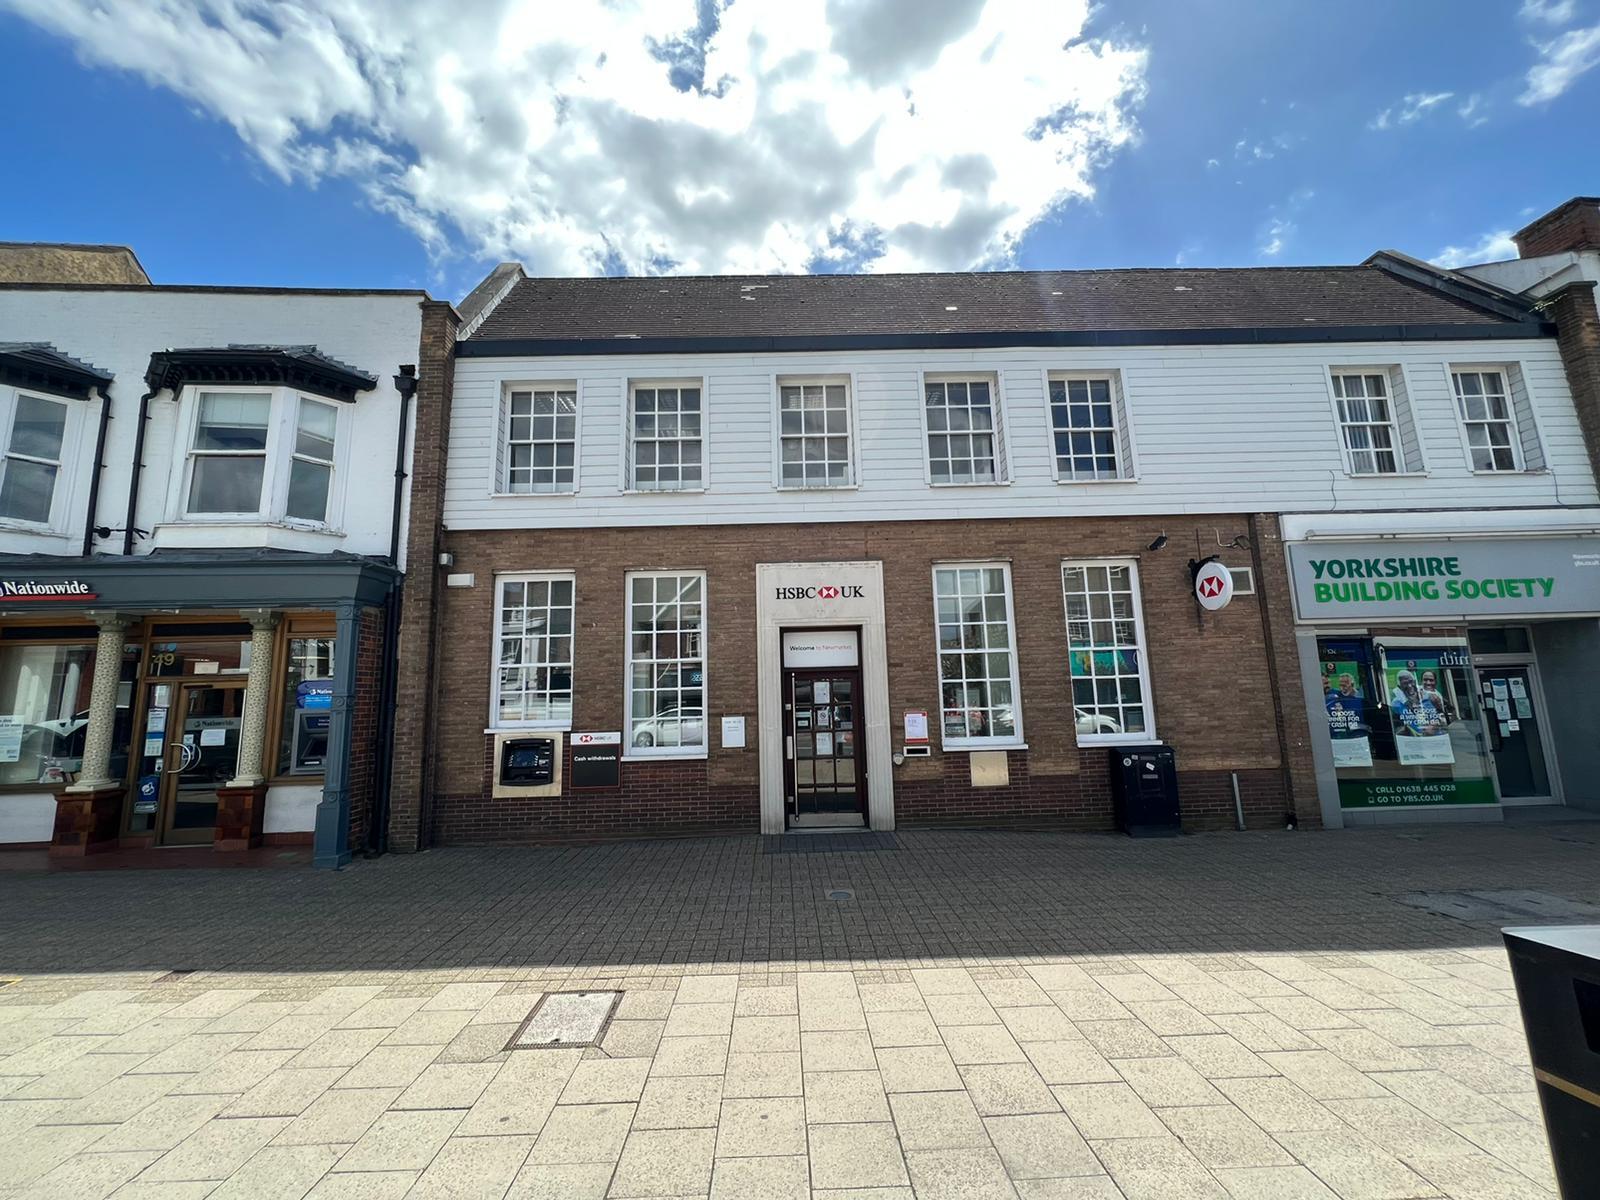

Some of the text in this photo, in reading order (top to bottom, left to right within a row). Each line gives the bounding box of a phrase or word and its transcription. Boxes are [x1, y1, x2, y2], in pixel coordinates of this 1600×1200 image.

[1309, 557, 1461, 579] YORKSHIRE
[3, 581, 89, 595] Nationwide
[776, 585, 865, 600] HSBC UK
[1314, 577, 1554, 602] BUILDING SOCIETY
[1375, 786, 1395, 794] CALL
[1423, 784, 1439, 792] 445
[1440, 784, 1457, 792] 028
[1390, 795, 1402, 803] TO
[1402, 794, 1445, 803] YBS.CO.UK
